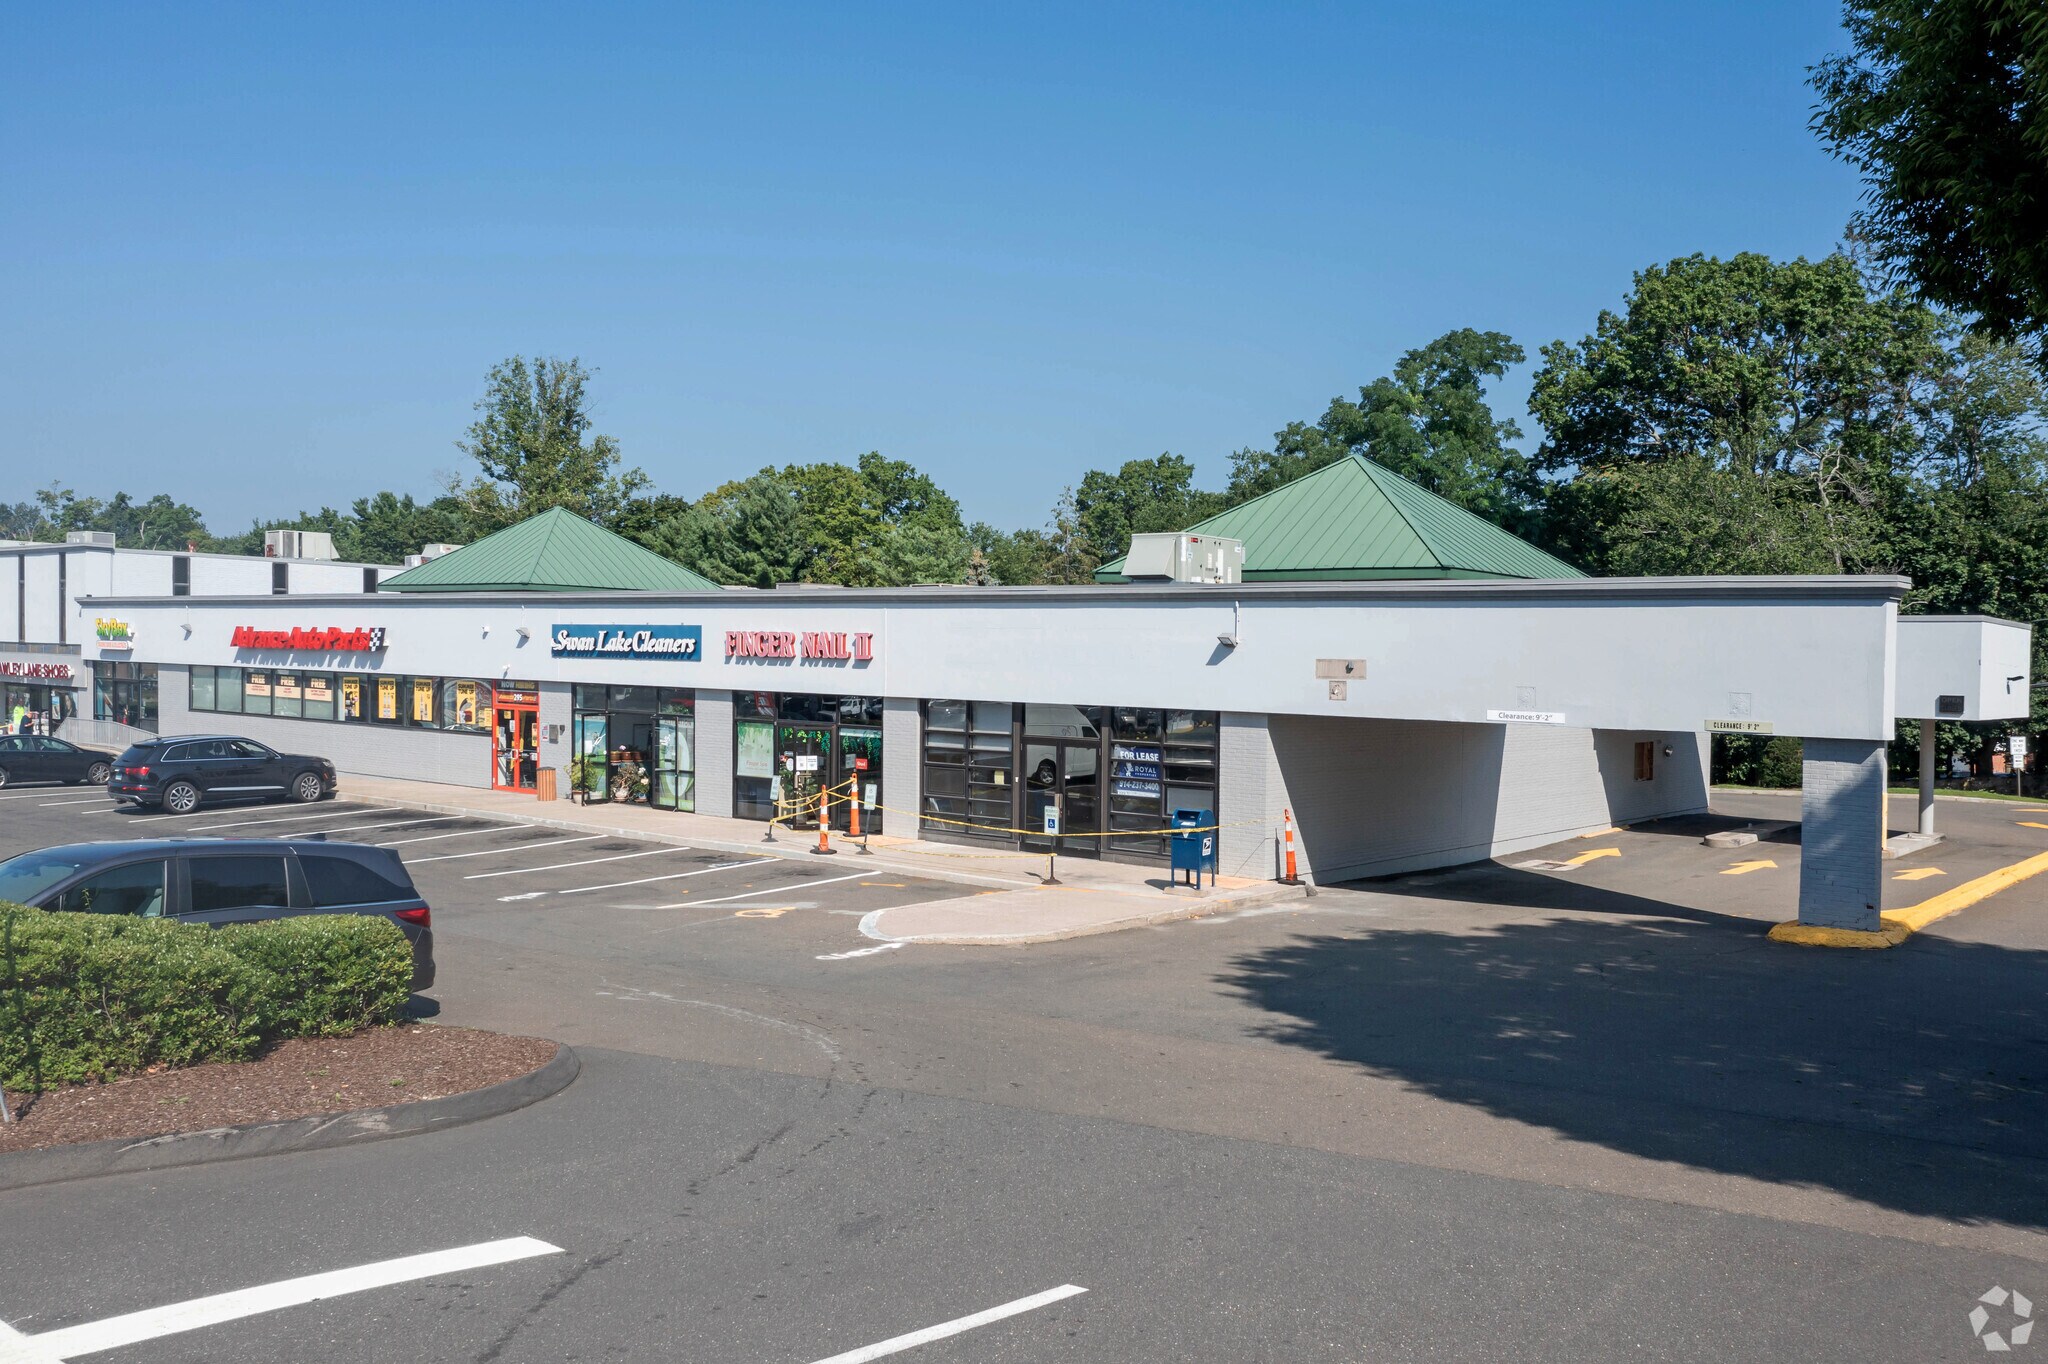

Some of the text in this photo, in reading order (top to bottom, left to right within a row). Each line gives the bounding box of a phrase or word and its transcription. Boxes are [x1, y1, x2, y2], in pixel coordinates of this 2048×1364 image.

[230, 626, 370, 651] Advance Auto Parts
[551, 629, 696, 653] Swan Lake Cleaners
[725, 631, 873, 660] FINGER NAIL II
[22, 662, 42, 677] LANE
[43, 664, 69, 679] SHOES
[513, 693, 523, 701] 295
[1498, 712, 1535, 720] Clearance:
[1713, 721, 1745, 730] CLEARANCE:
[1120, 751, 1160, 762] FOR LEASE
[1119, 780, 1160, 791] 914-237-3400
